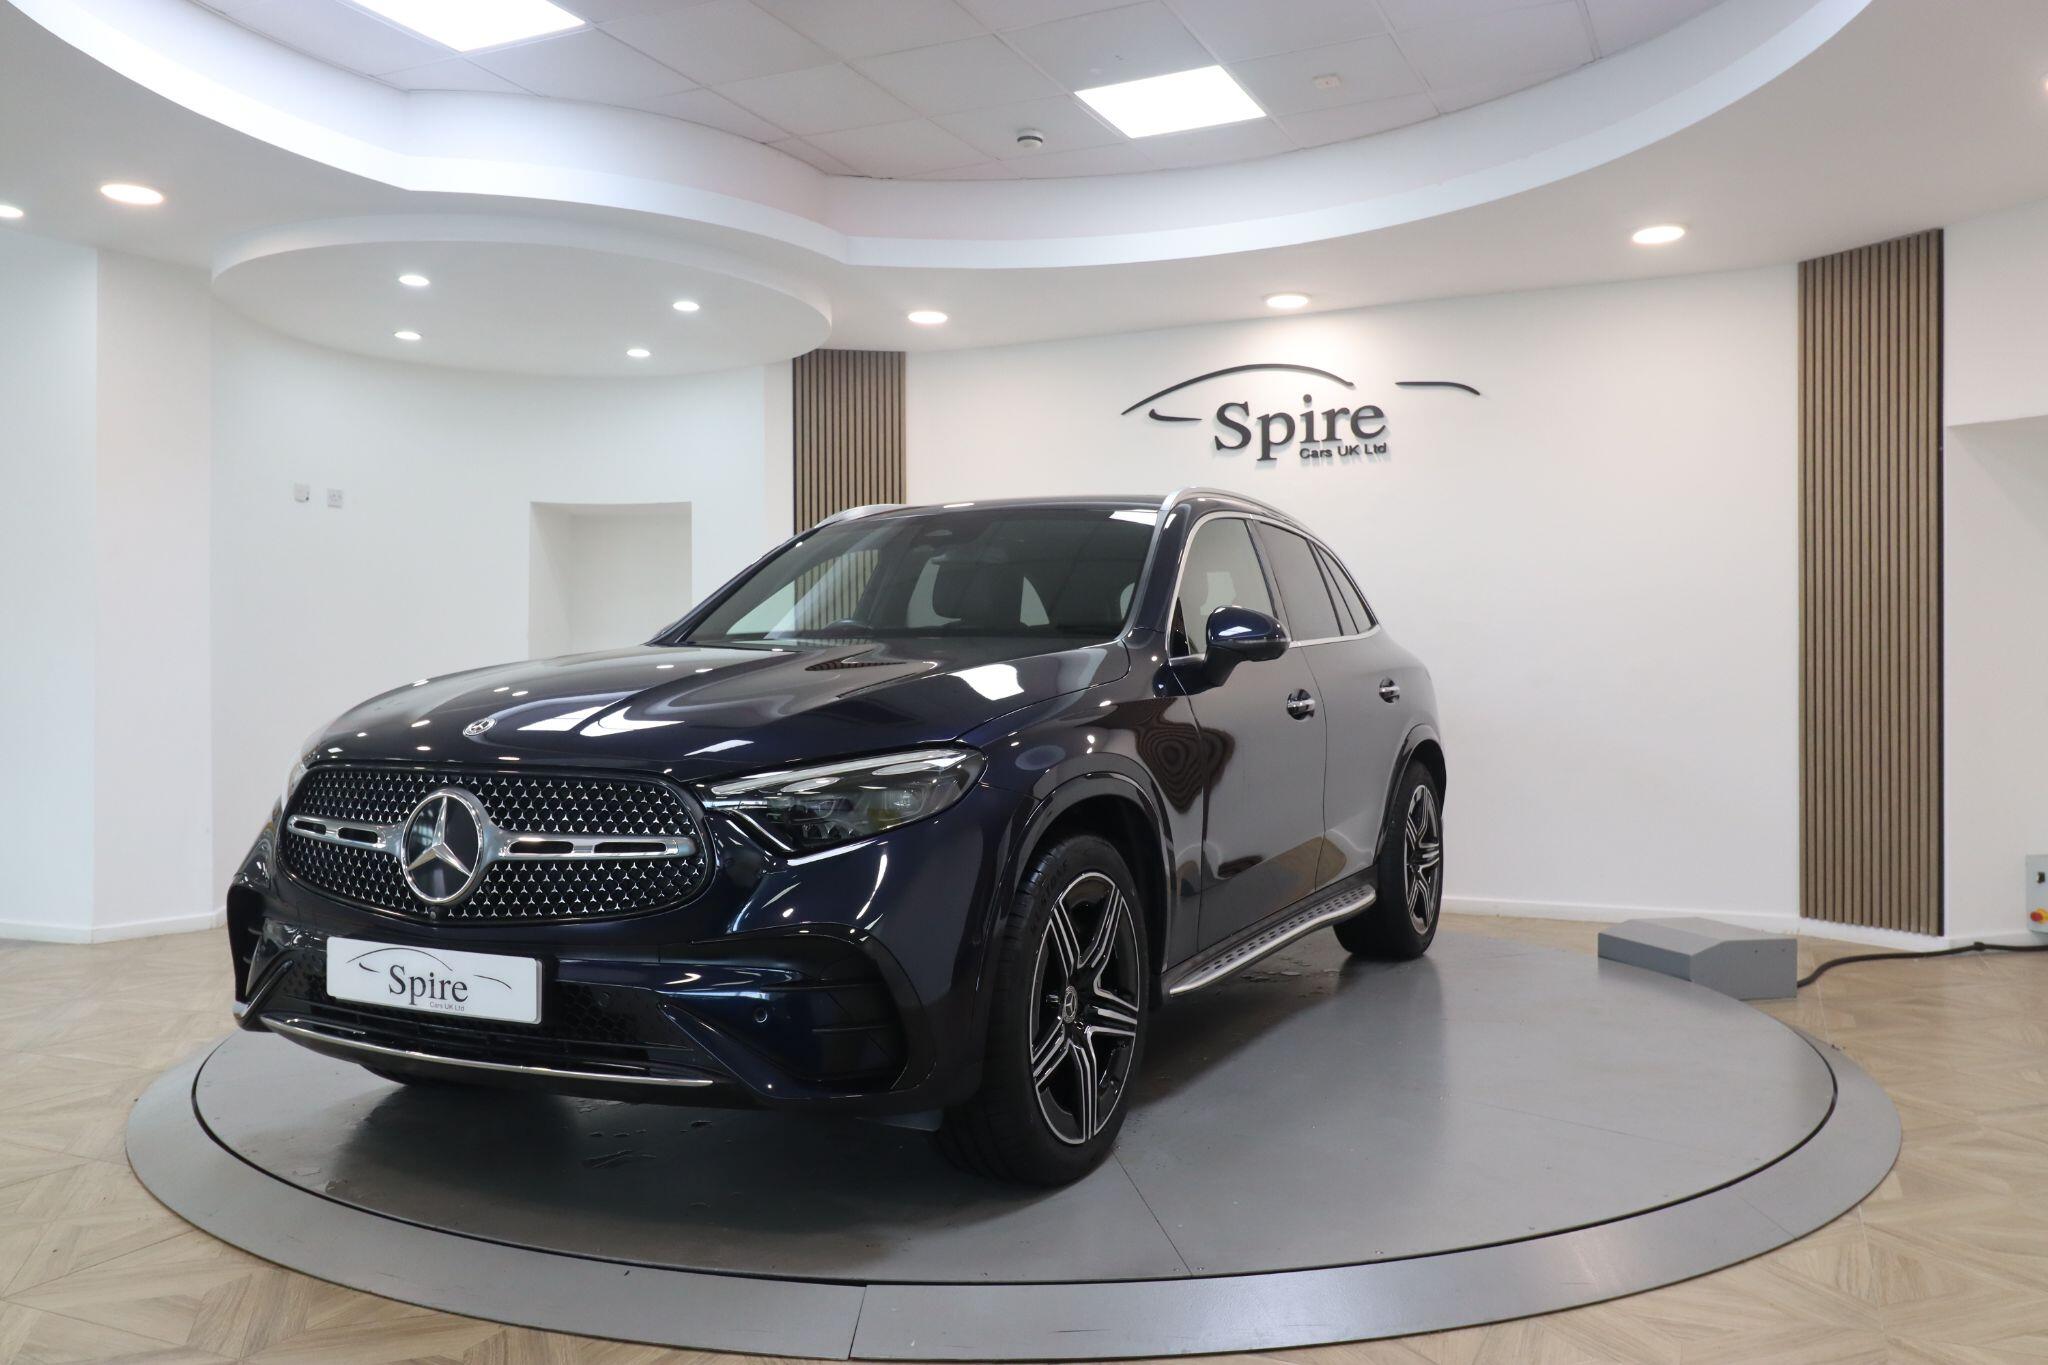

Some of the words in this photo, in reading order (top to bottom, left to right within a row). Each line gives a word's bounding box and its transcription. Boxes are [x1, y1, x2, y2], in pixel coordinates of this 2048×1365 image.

[1214, 394, 1386, 461] Spire
[1300, 447, 1332, 459] Cars
[1337, 444, 1360, 457] UK
[1364, 442, 1387, 455] Ltd
[389, 964, 468, 1006] Spire
[429, 1001, 444, 1009] Cars
[444, 1003, 454, 1011] UK
